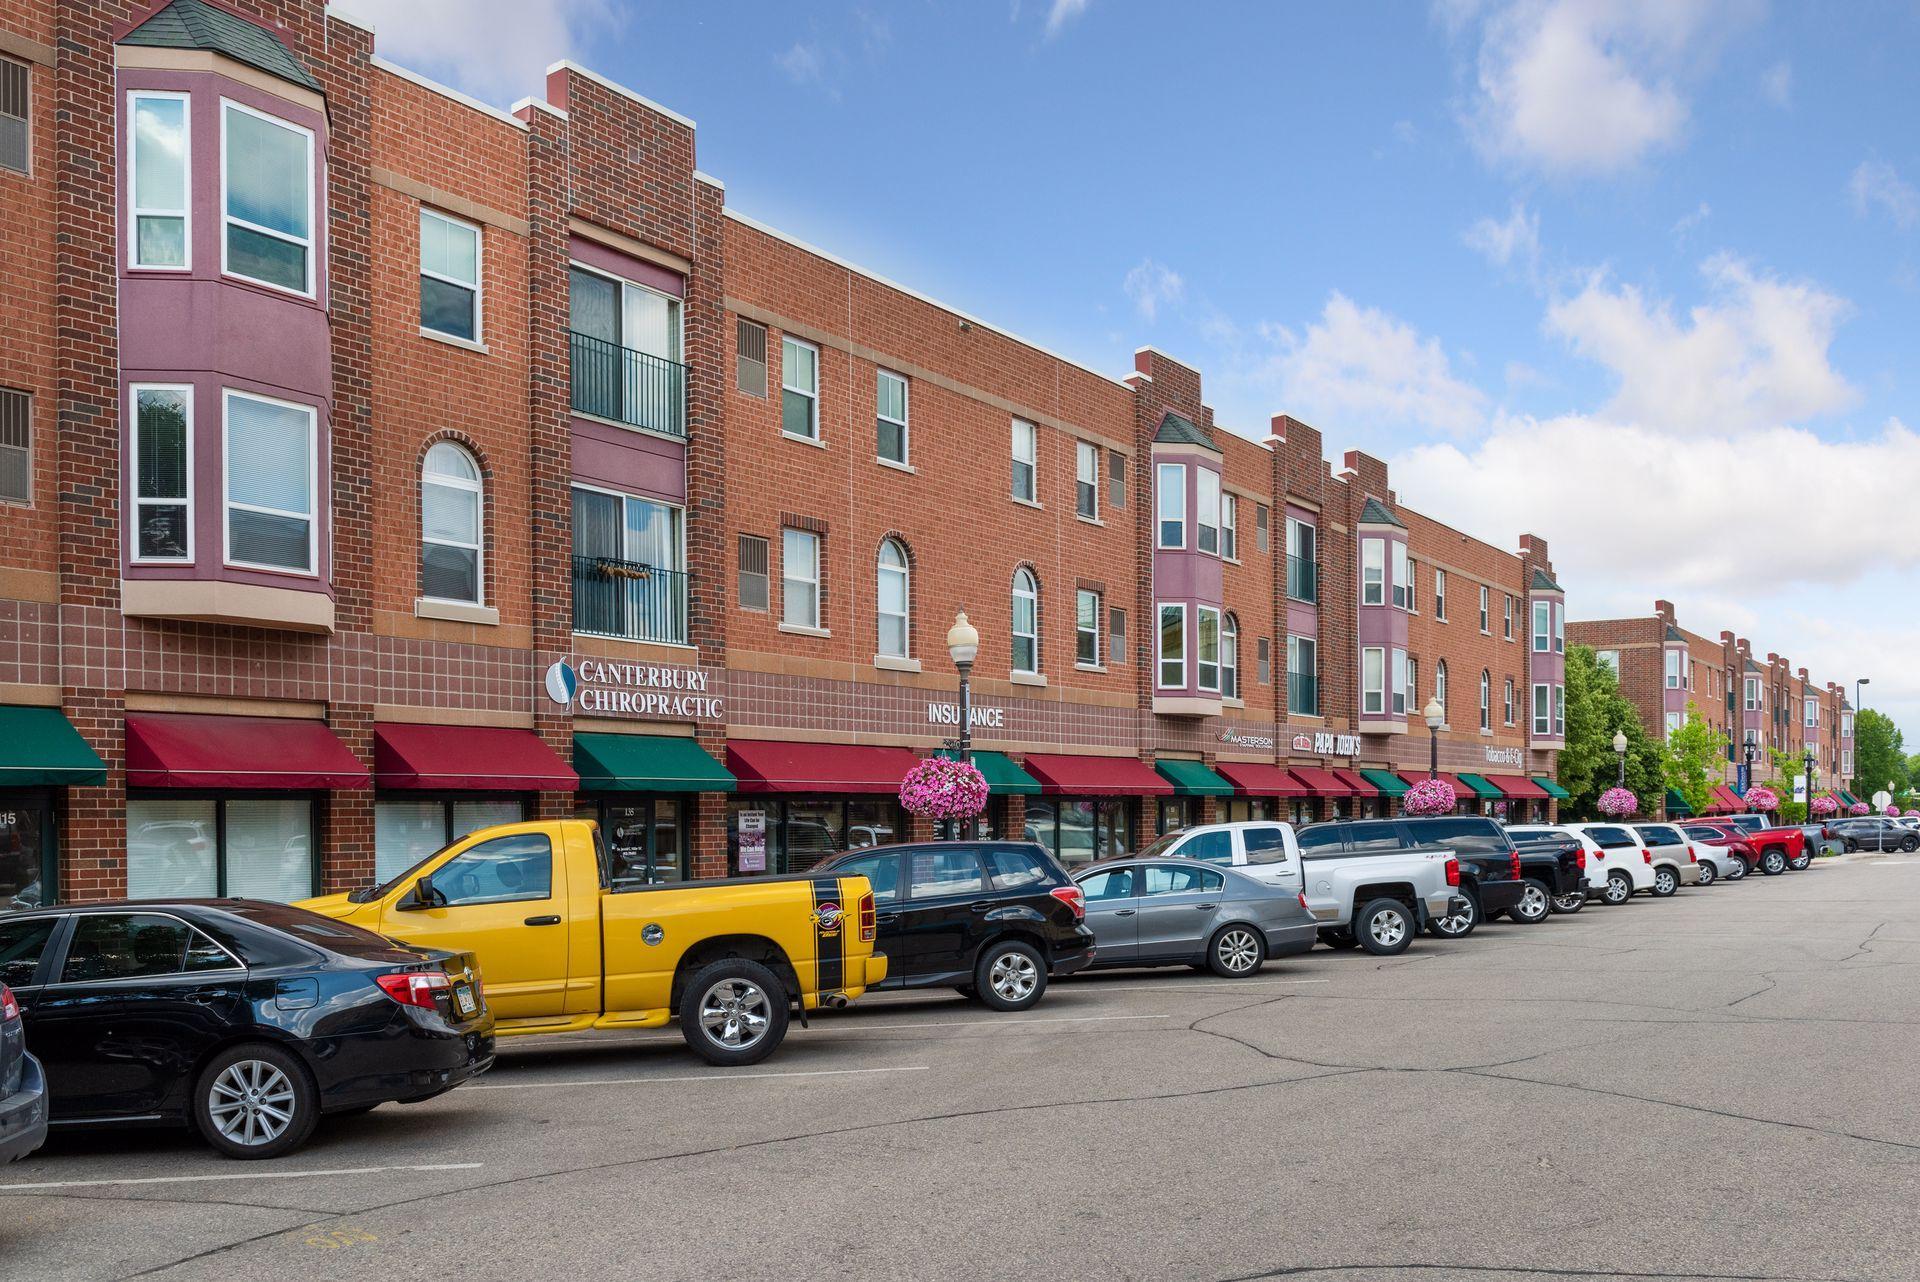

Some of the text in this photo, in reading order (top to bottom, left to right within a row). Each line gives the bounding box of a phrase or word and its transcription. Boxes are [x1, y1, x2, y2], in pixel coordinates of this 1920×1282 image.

[578, 660, 708, 692] CANTERBURY
[579, 689, 723, 719] CHIROPRACTIC
[928, 703, 1004, 727] INSUANCE
[1230, 735, 1273, 746] MASTERSON
[1313, 732, 1334, 755] PAPA
[1336, 734, 1361, 756] JOHN'S
